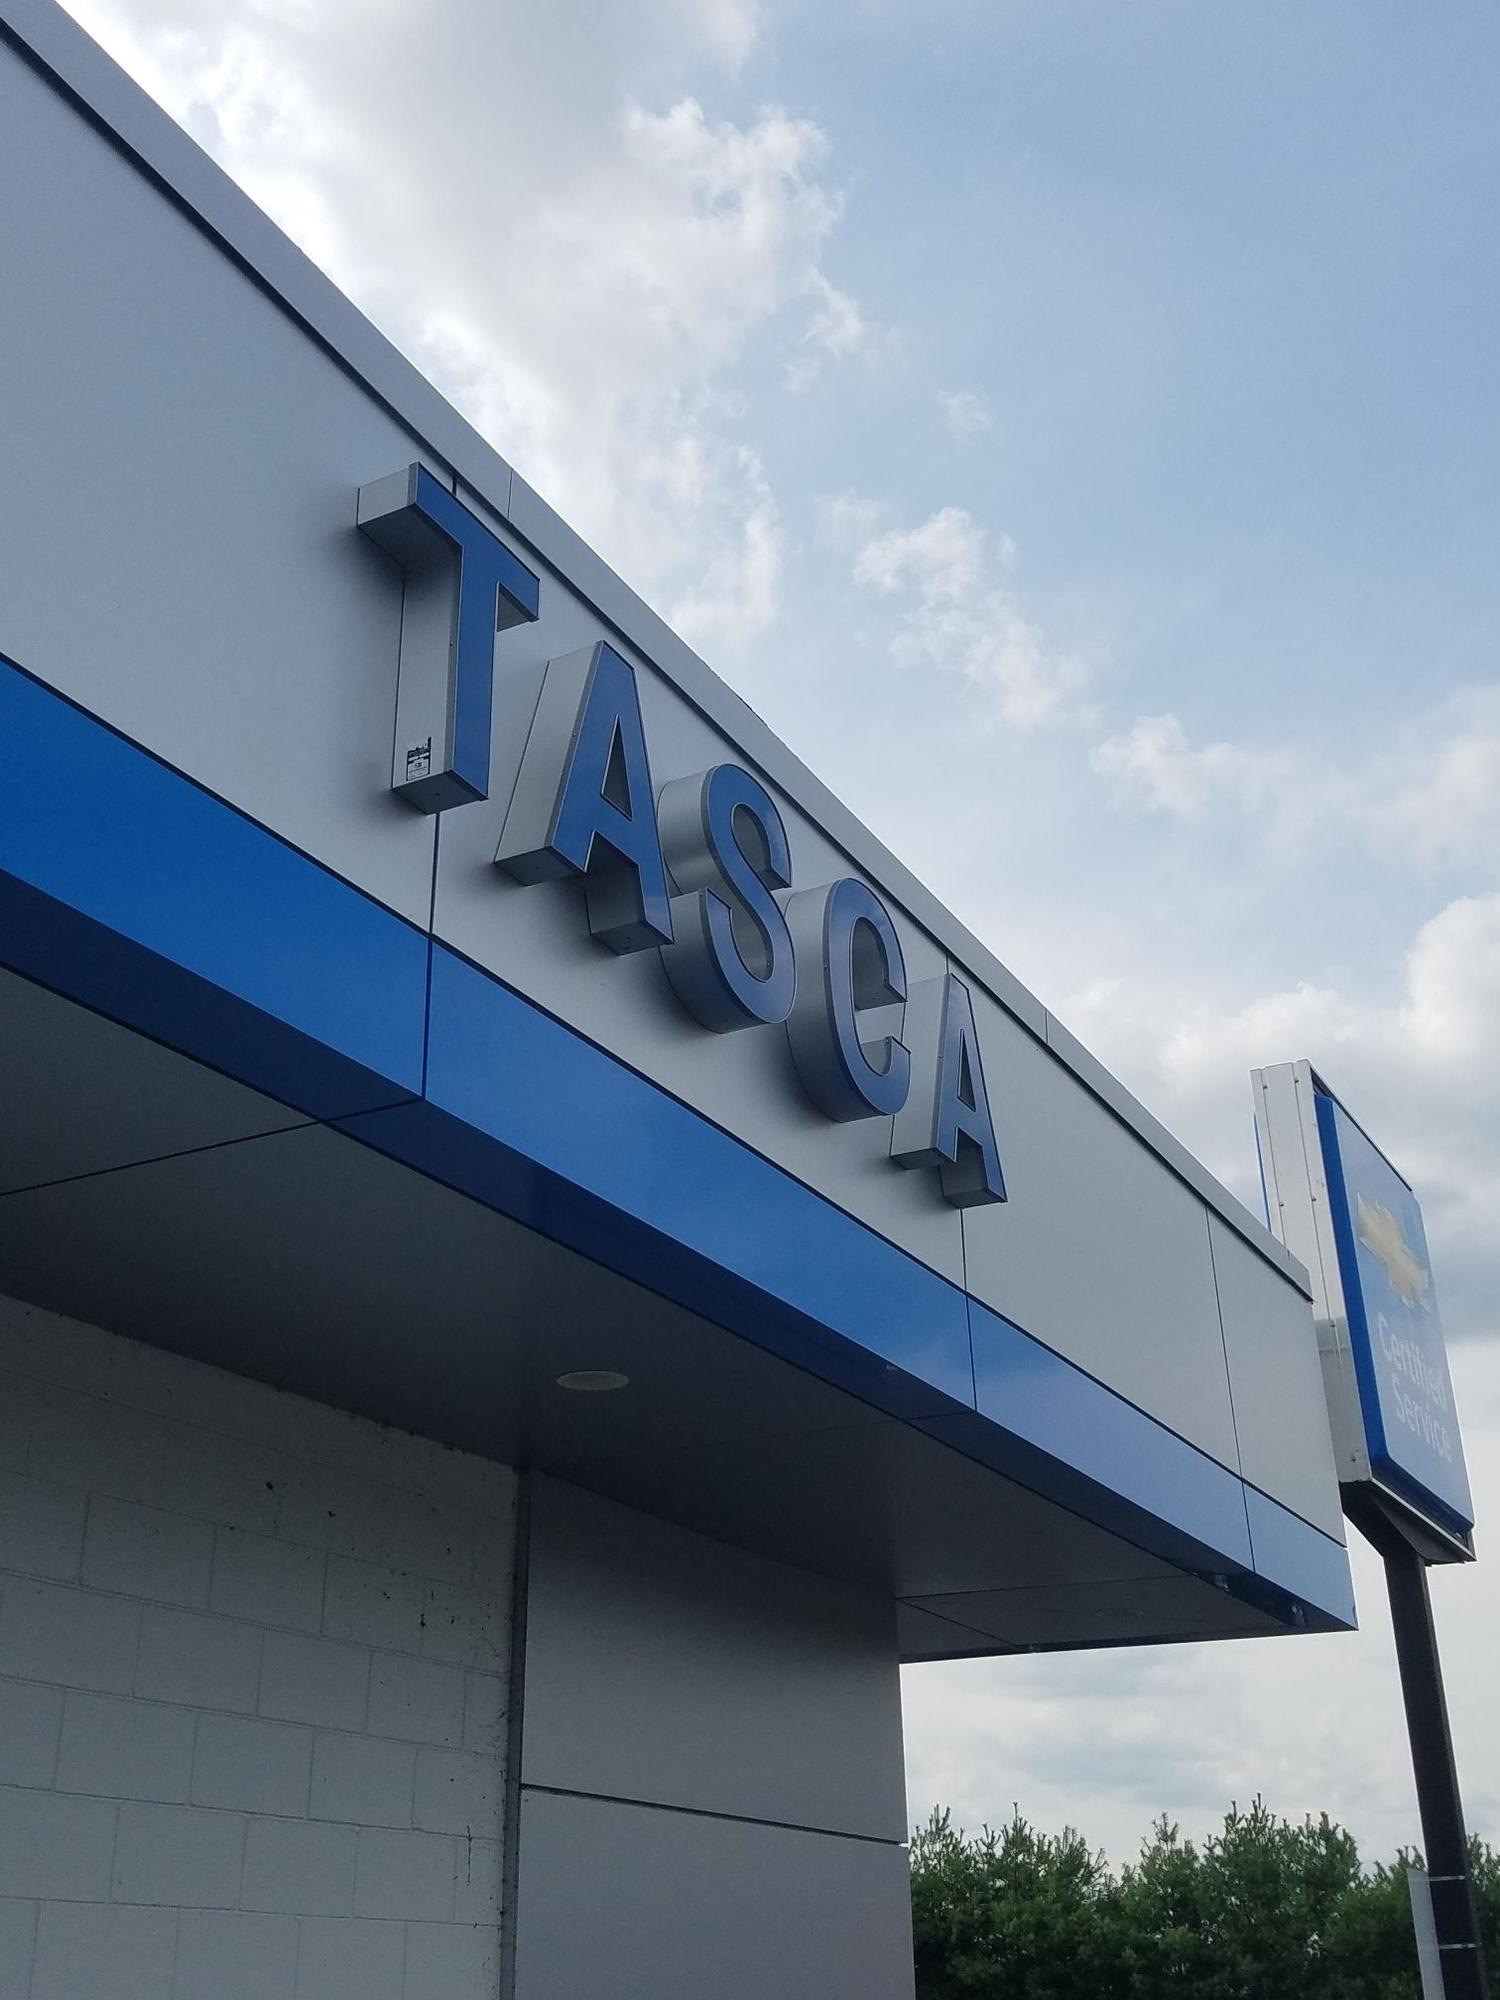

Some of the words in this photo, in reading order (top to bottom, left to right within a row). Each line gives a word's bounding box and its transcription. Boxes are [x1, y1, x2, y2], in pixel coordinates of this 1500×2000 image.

[408, 462, 1008, 1203] TASCA
[1379, 1312, 1447, 1410] Certified
[1391, 1372, 1453, 1463] Service
